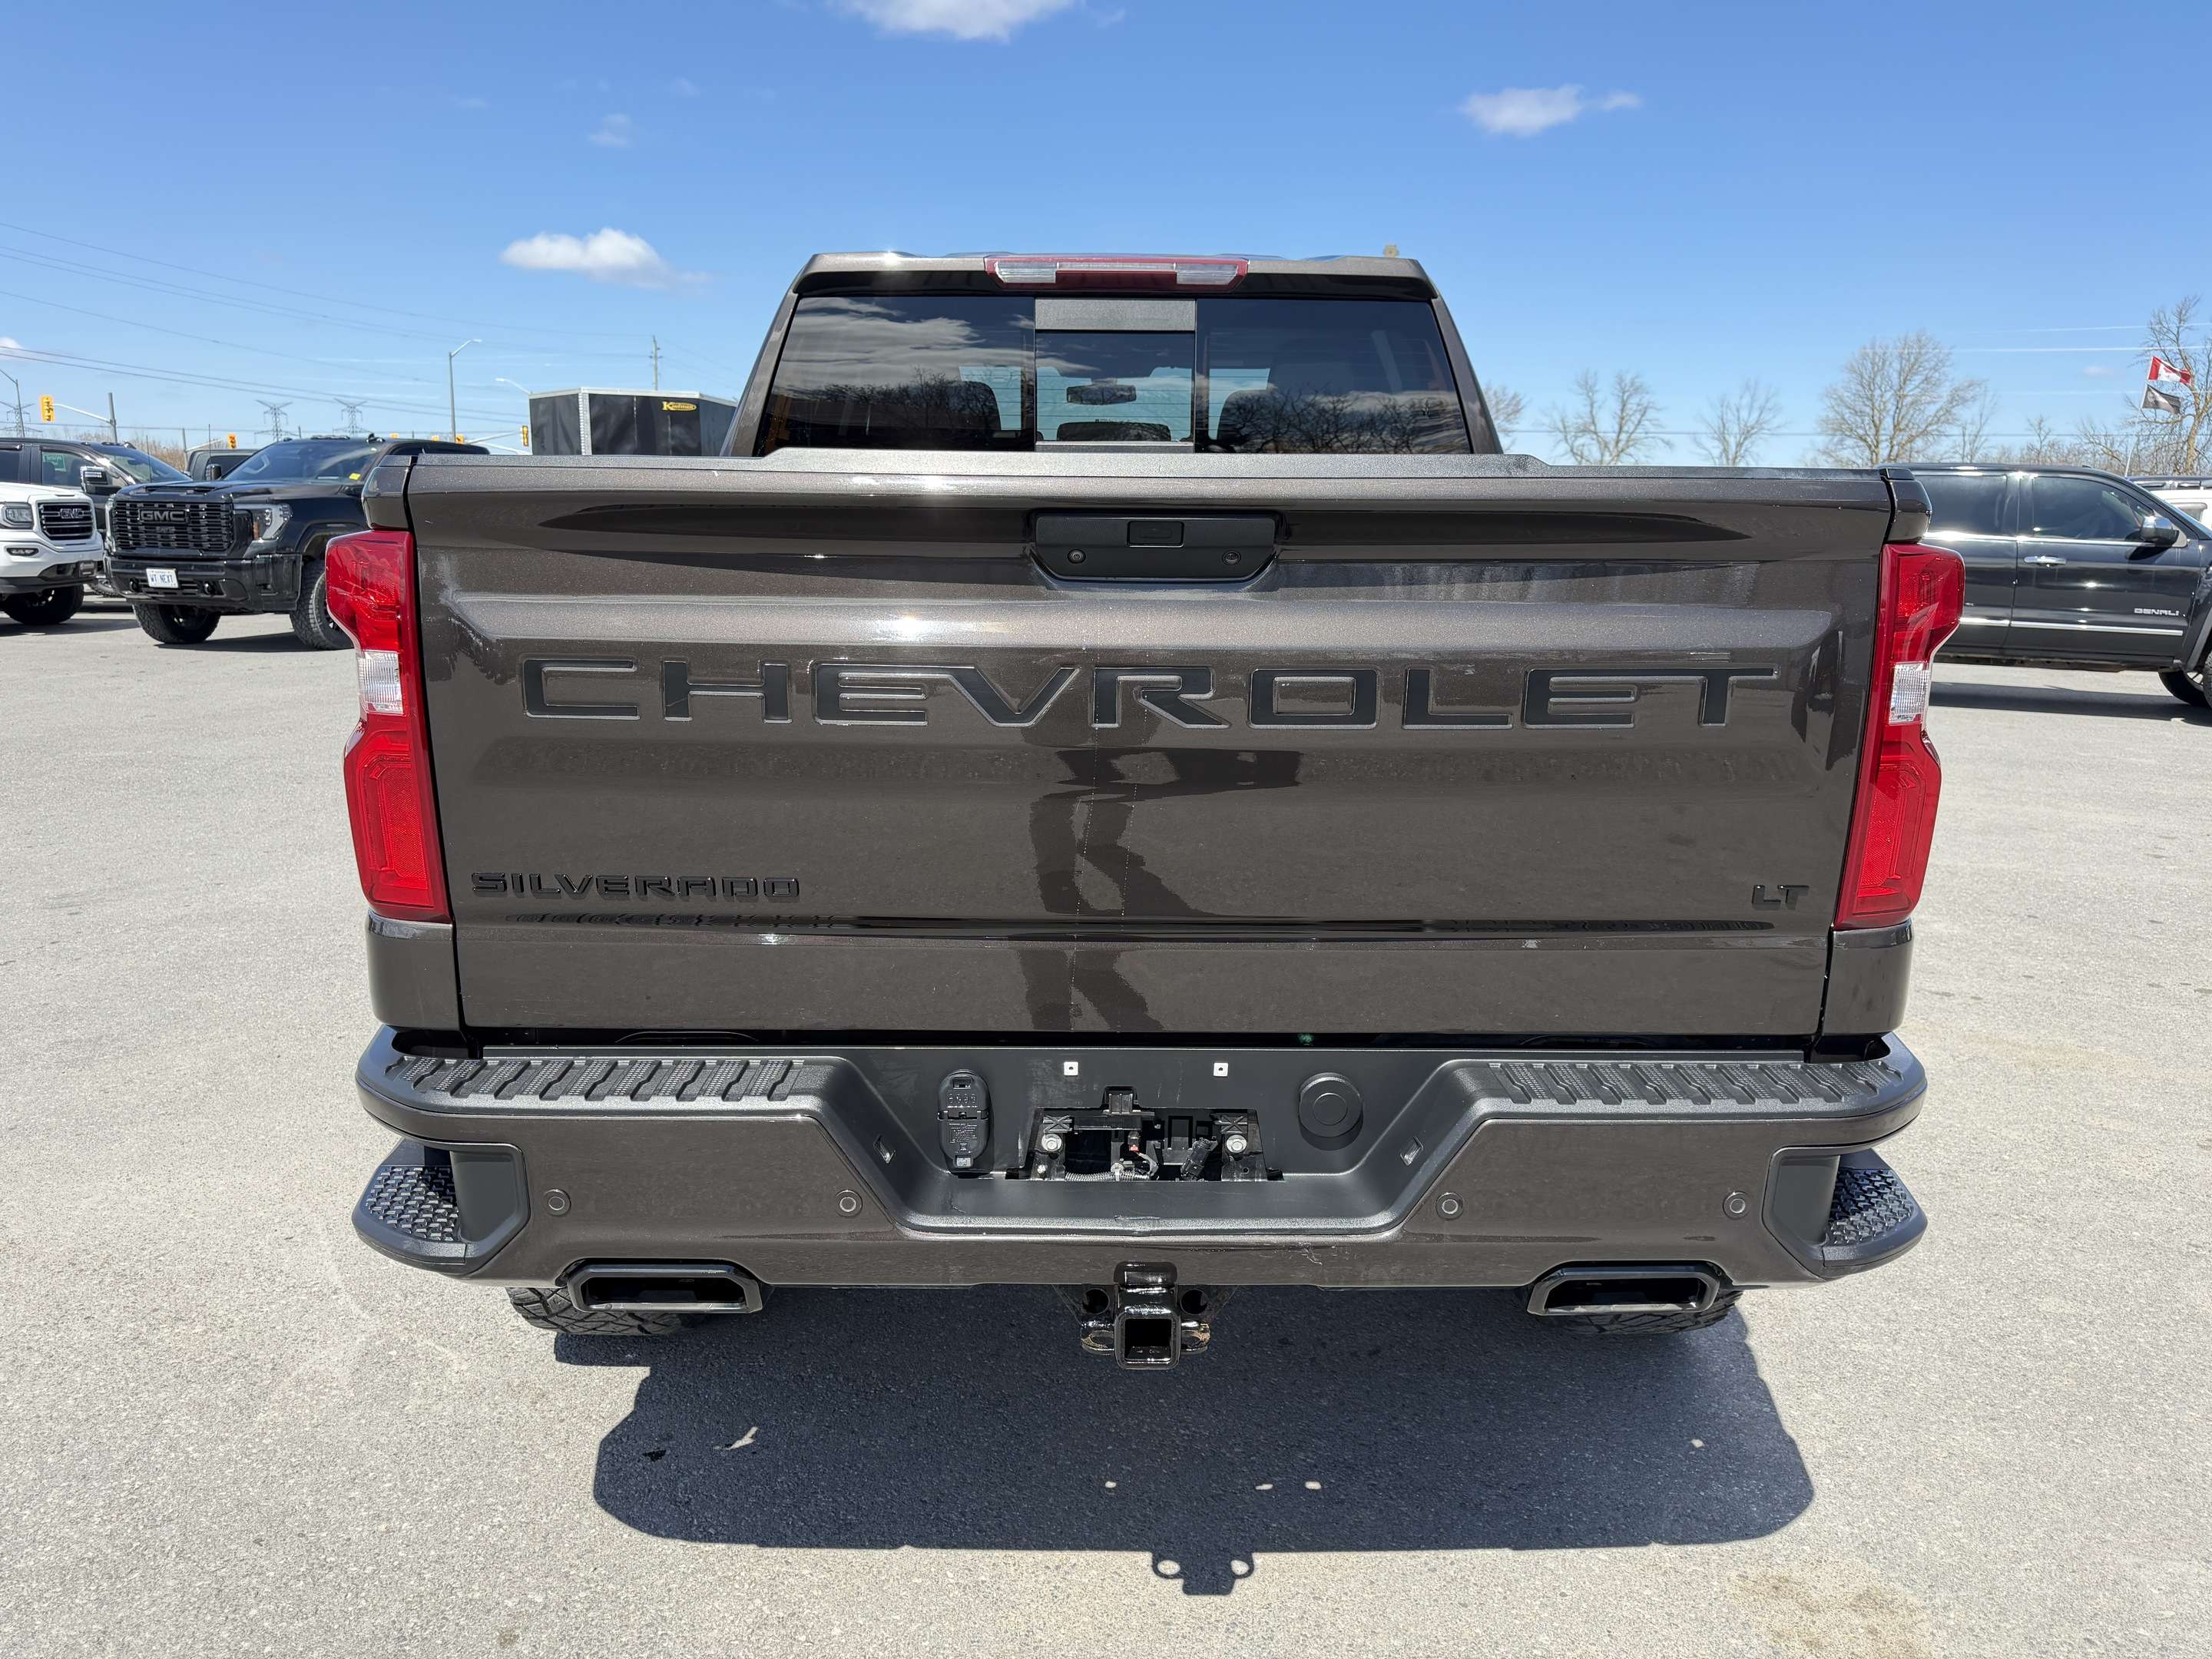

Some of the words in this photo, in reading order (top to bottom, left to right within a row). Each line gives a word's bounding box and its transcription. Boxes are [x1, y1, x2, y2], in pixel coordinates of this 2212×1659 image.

[141, 510, 184, 521] GMC
[2134, 608, 2180, 616] DENALI
[522, 656, 1780, 729] CHEVROLET
[471, 873, 800, 898] SILVERADO
[1751, 885, 1810, 909] LT
